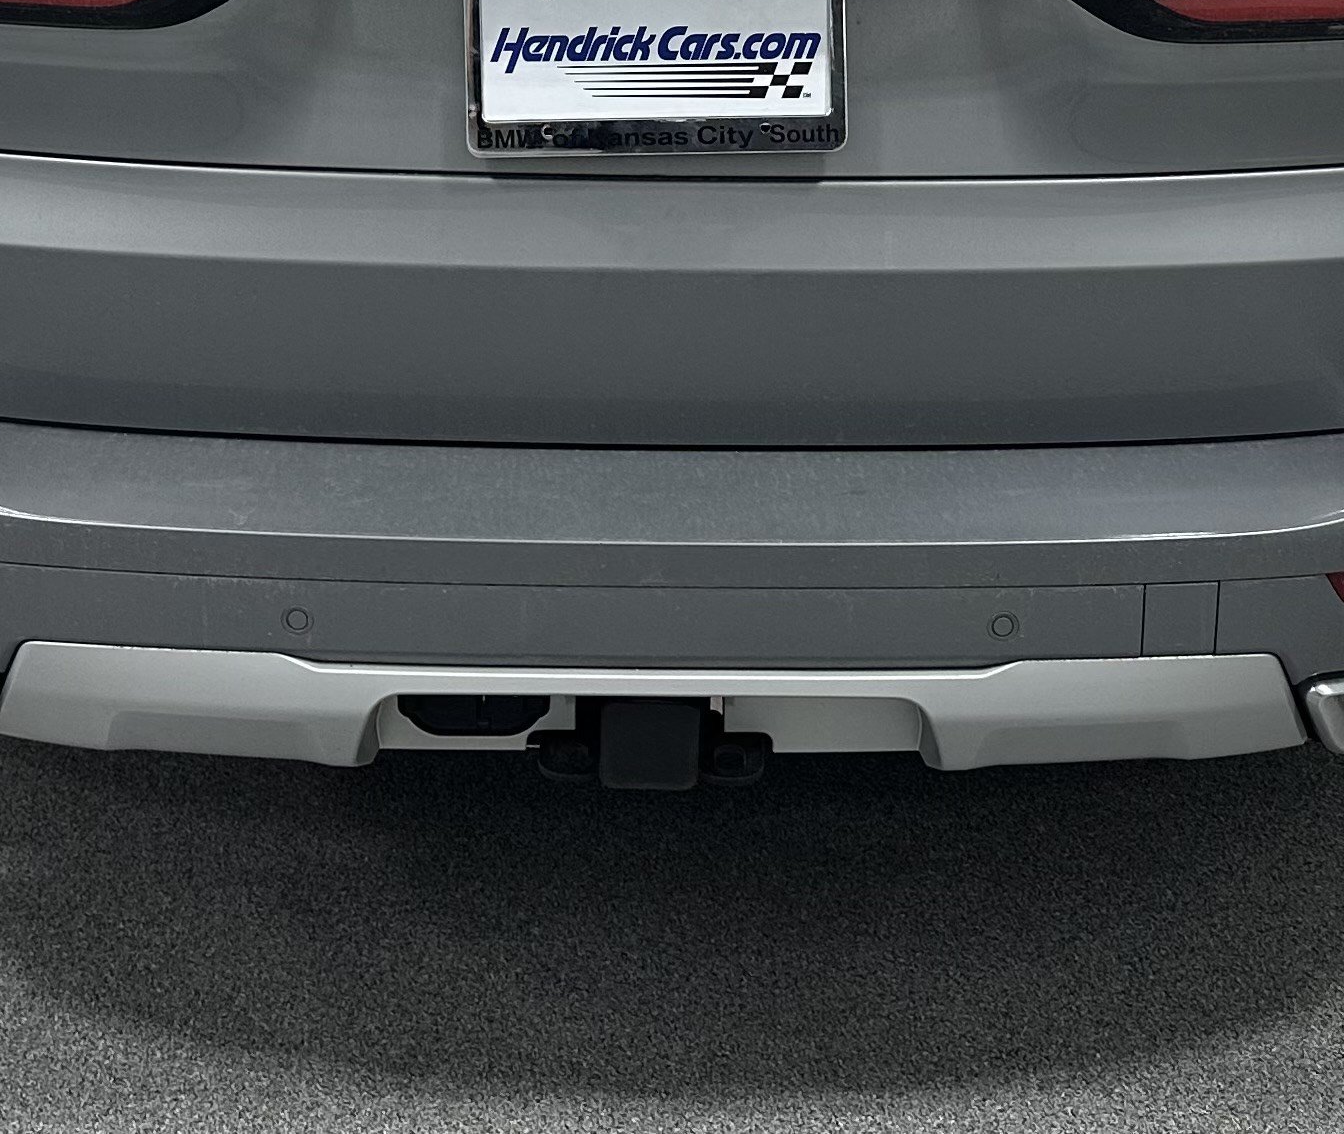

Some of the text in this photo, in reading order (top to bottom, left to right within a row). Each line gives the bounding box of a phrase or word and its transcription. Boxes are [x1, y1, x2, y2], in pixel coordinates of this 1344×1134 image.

[477, 128, 541, 150] BMW
[697, 125, 754, 149] City
[769, 123, 839, 144] South
